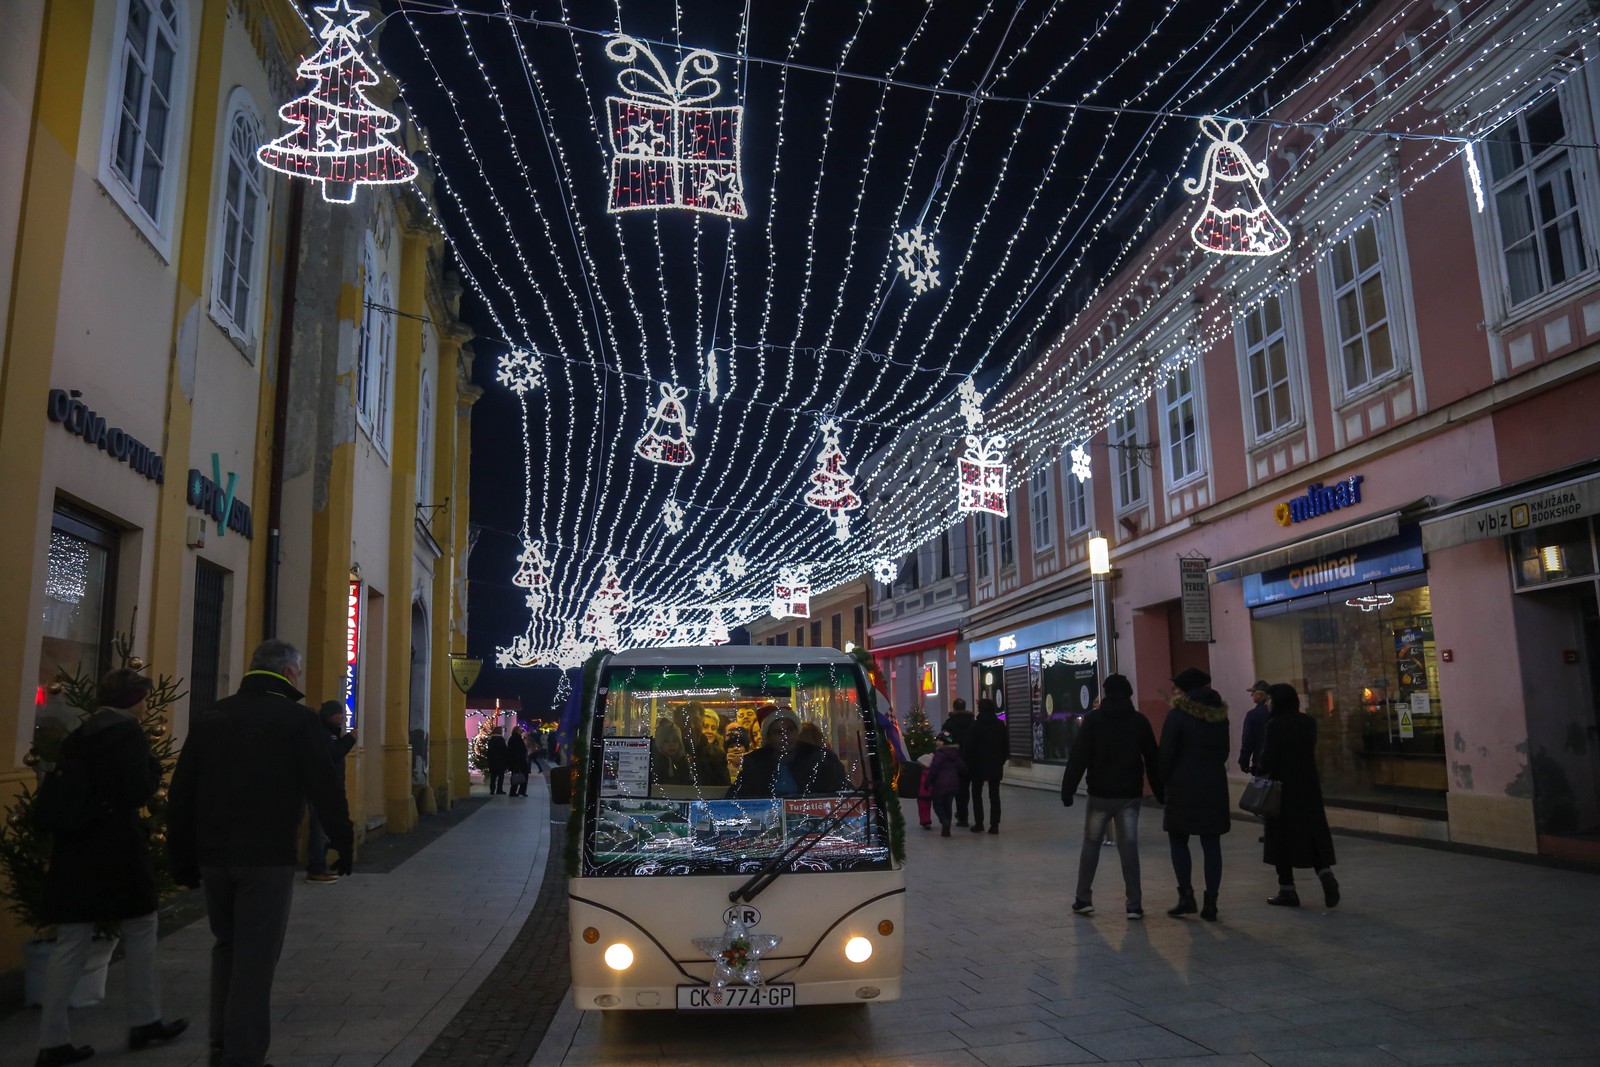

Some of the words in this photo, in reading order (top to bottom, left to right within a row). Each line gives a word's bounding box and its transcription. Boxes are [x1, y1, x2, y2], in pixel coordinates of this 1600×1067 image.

[47, 389, 107, 450] OČNA
[106, 428, 164, 484] OPTIKA
[1290, 476, 1364, 523] mlinar
[1530, 493, 1576, 512] KNJIŽARA
[1532, 504, 1581, 523] BOOKSHOP
[1303, 553, 1358, 588] mlinar
[726, 987, 791, 1007] 774-GP
